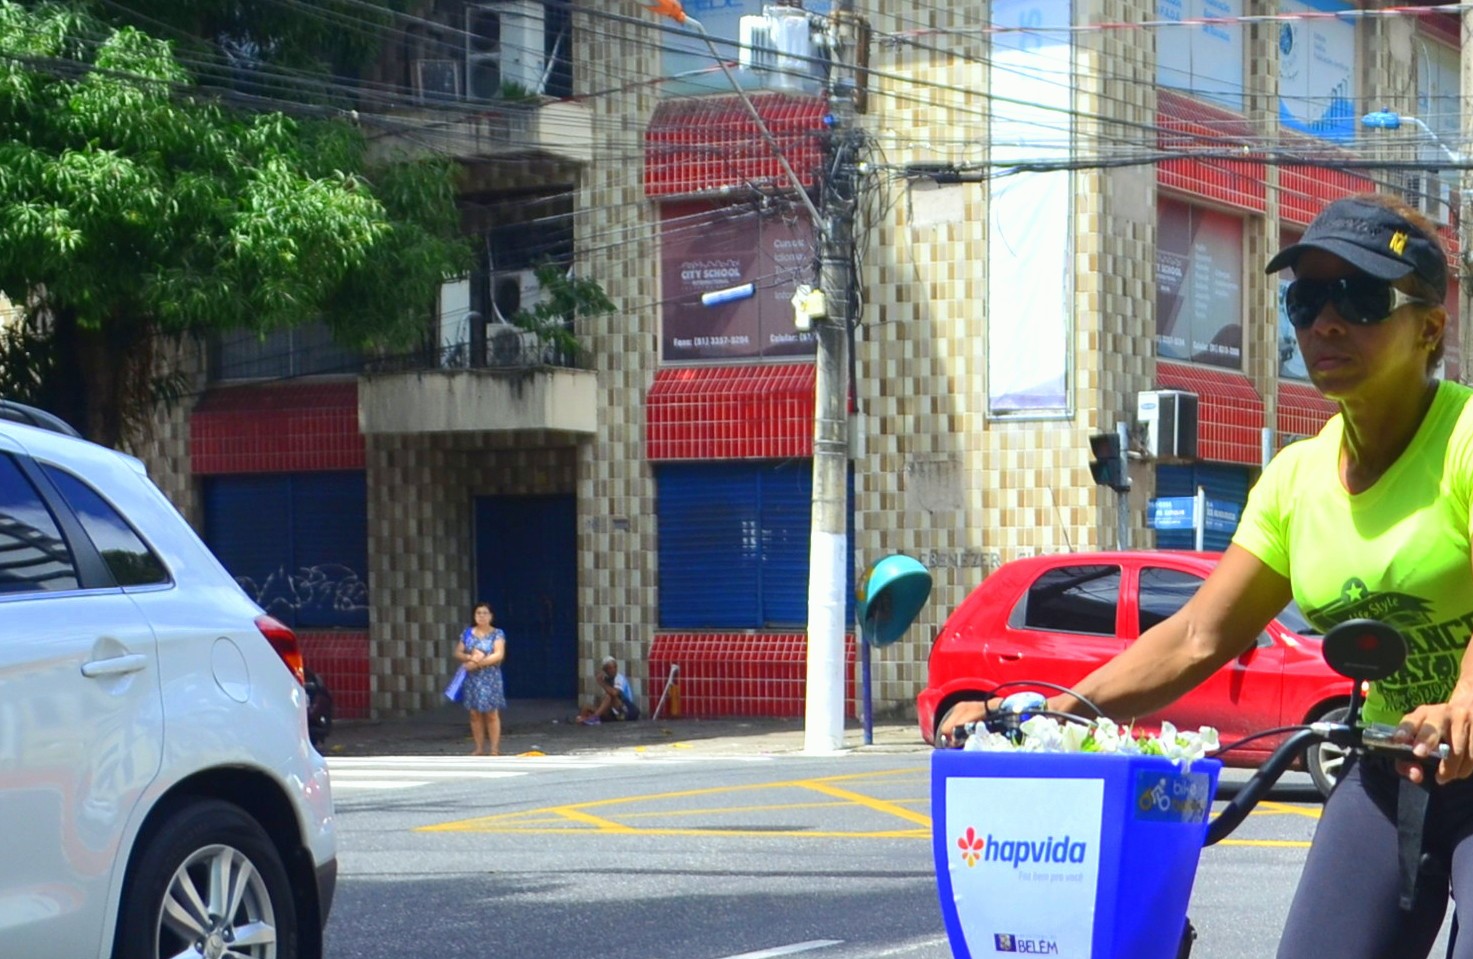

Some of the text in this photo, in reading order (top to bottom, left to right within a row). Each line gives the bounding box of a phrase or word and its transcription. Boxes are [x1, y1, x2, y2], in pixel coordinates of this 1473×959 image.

[681, 267, 741, 281] CITY SCHOOL
[1368, 596, 1399, 615] Style
[984, 833, 1087, 869] hapvida
